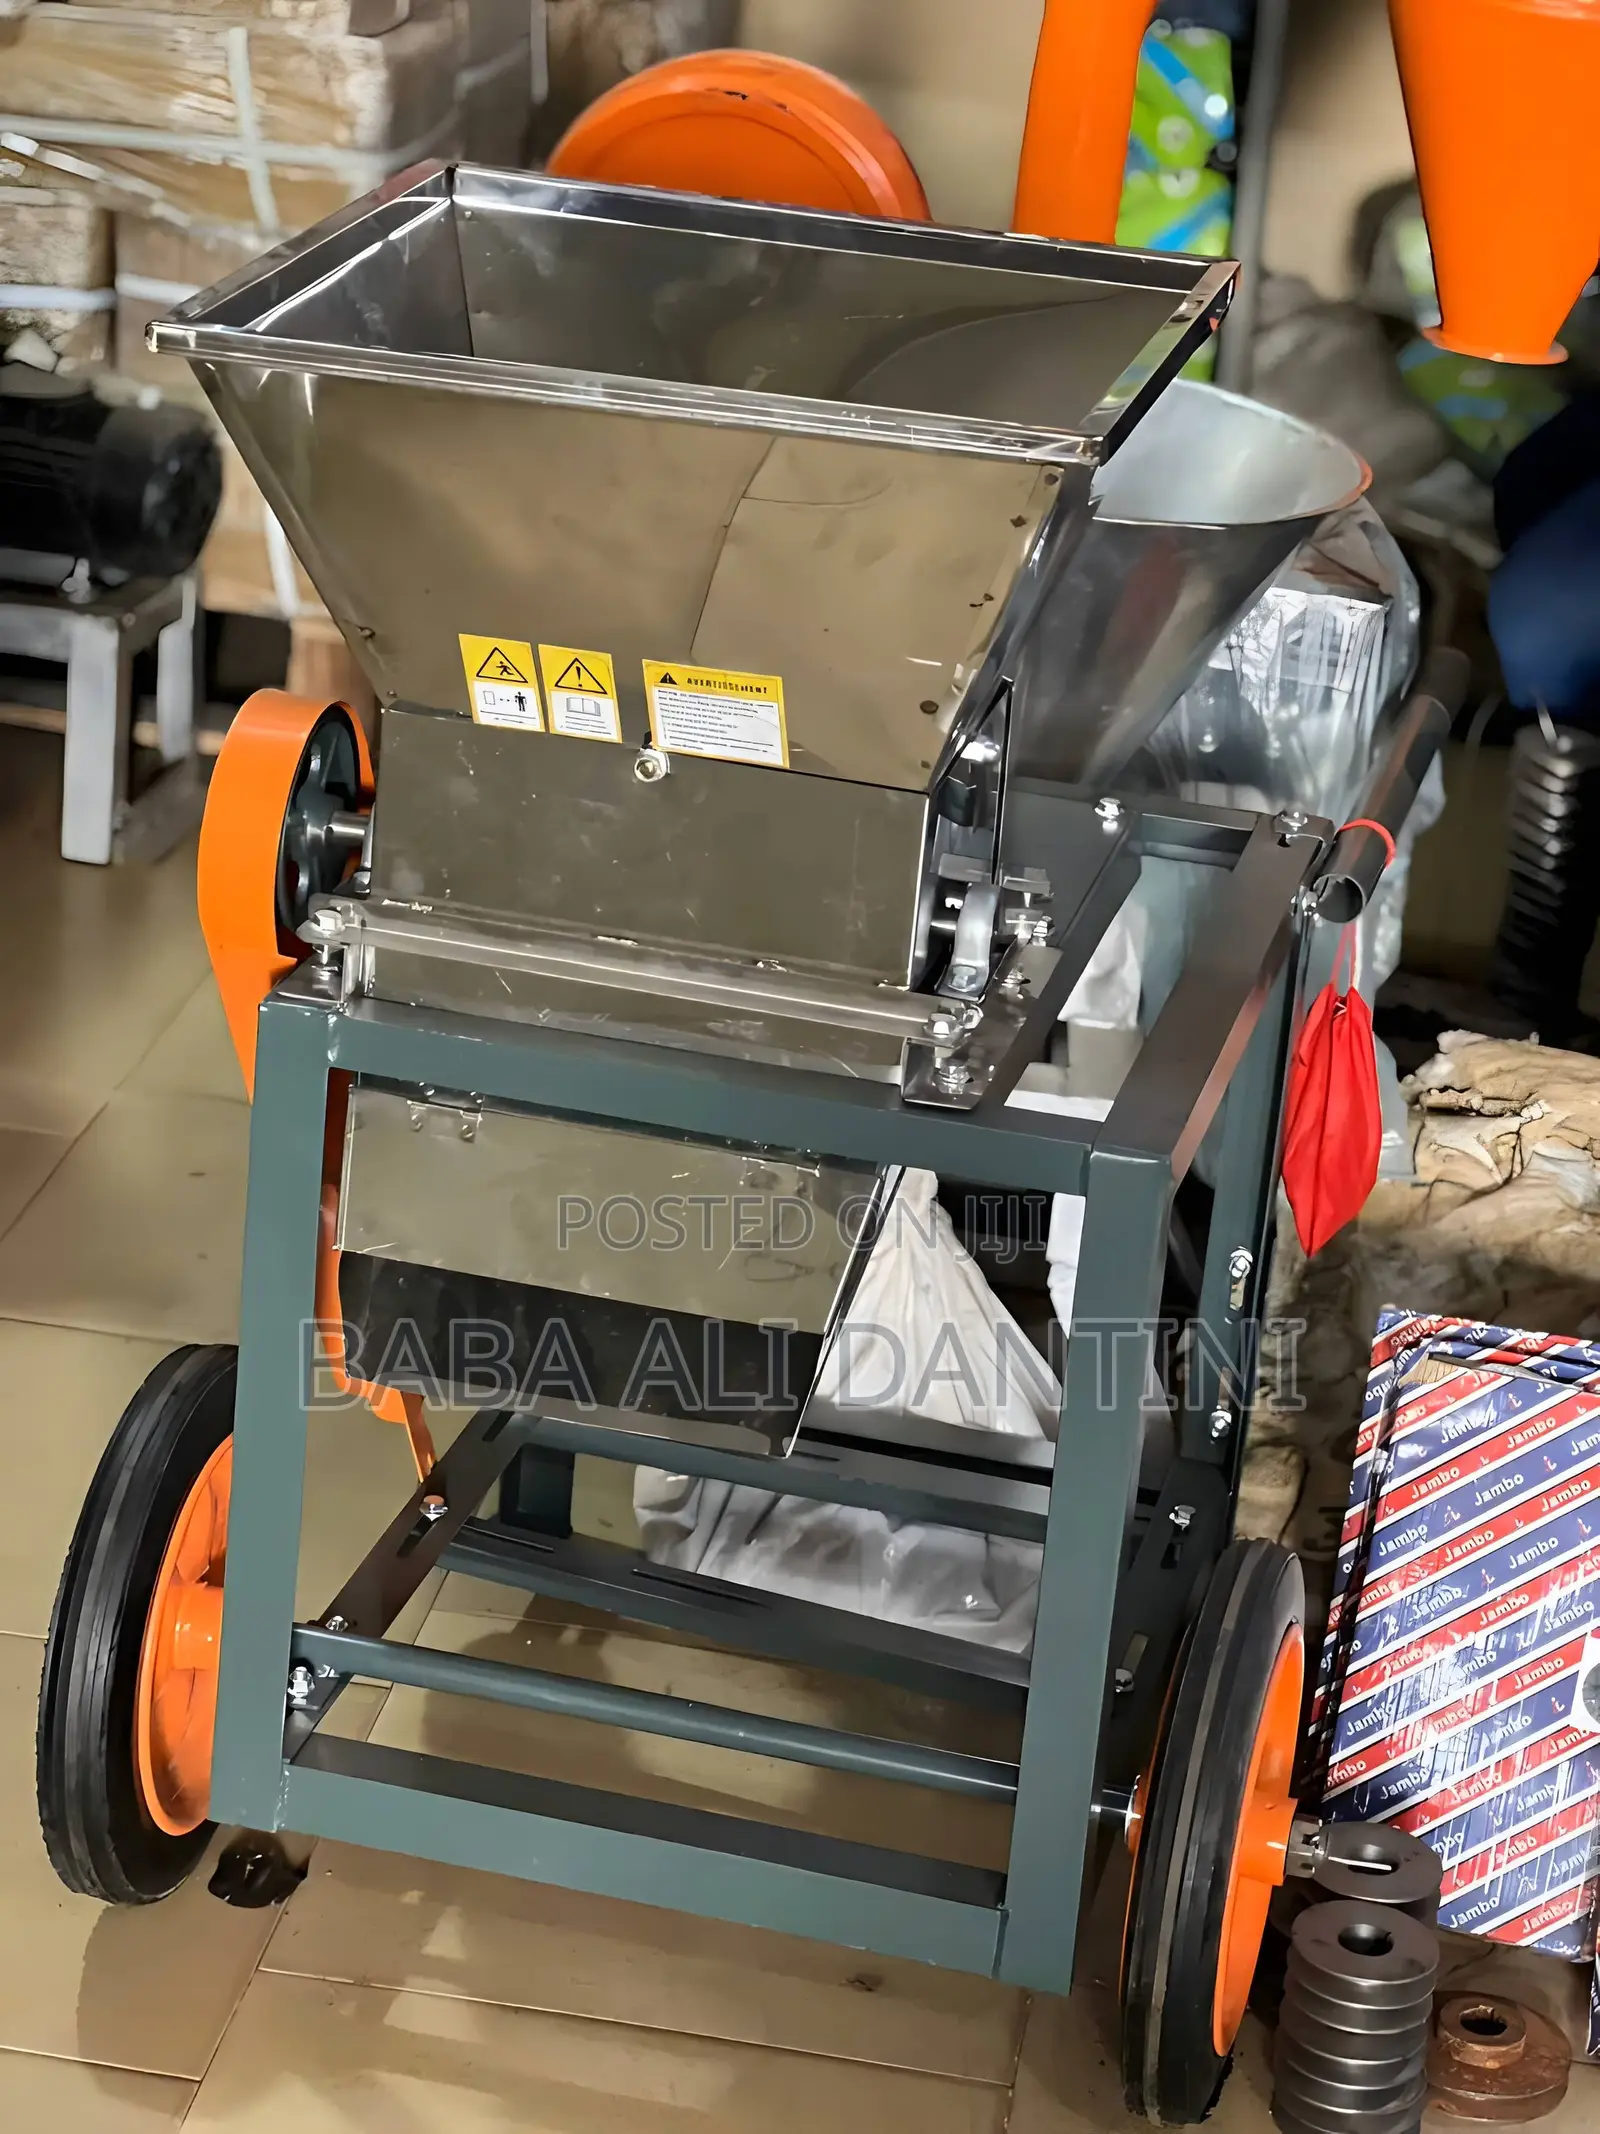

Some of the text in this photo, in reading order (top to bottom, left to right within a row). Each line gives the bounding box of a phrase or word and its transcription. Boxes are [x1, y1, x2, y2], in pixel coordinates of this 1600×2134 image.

[1411, 1417, 1557, 1499] Jambo Jambo
[1378, 1524, 1428, 1556] Jambo
[1474, 1474, 1524, 1506] Jambo
[1444, 1530, 1495, 1563] Jambo
[1541, 1480, 1591, 1512] Jambo
[1508, 1537, 1559, 1569] Jambo
[1480, 1594, 1530, 1625] Jambo
[1543, 1600, 1594, 1633] Jambo
[1514, 1657, 1564, 1690] Jambo
[1450, 1896, 1500, 1929] Jambo
[1522, 1901, 1574, 1934] Jambo
